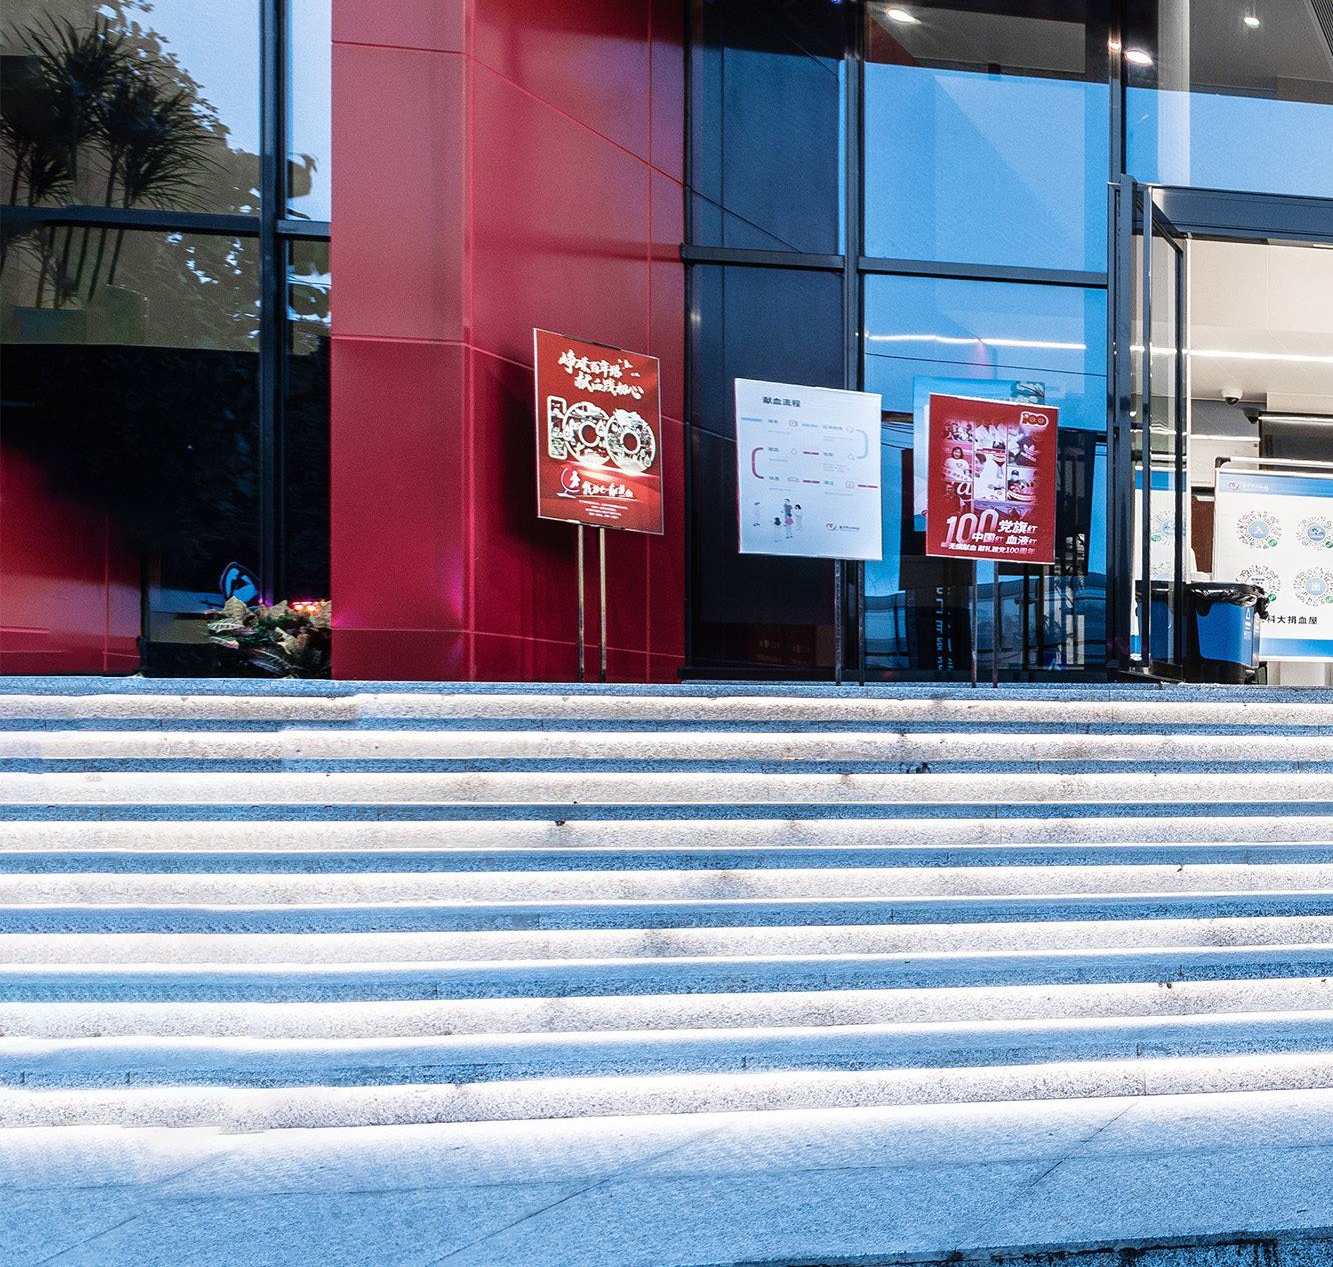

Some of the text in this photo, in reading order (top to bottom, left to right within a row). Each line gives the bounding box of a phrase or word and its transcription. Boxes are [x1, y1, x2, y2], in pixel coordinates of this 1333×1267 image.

[762, 396, 802, 408] 献血流程
[997, 519, 1038, 534] 党旗红
[972, 531, 1038, 546] 中国红 血液红
[1261, 615, 1318, 625] 科大捐血屋
